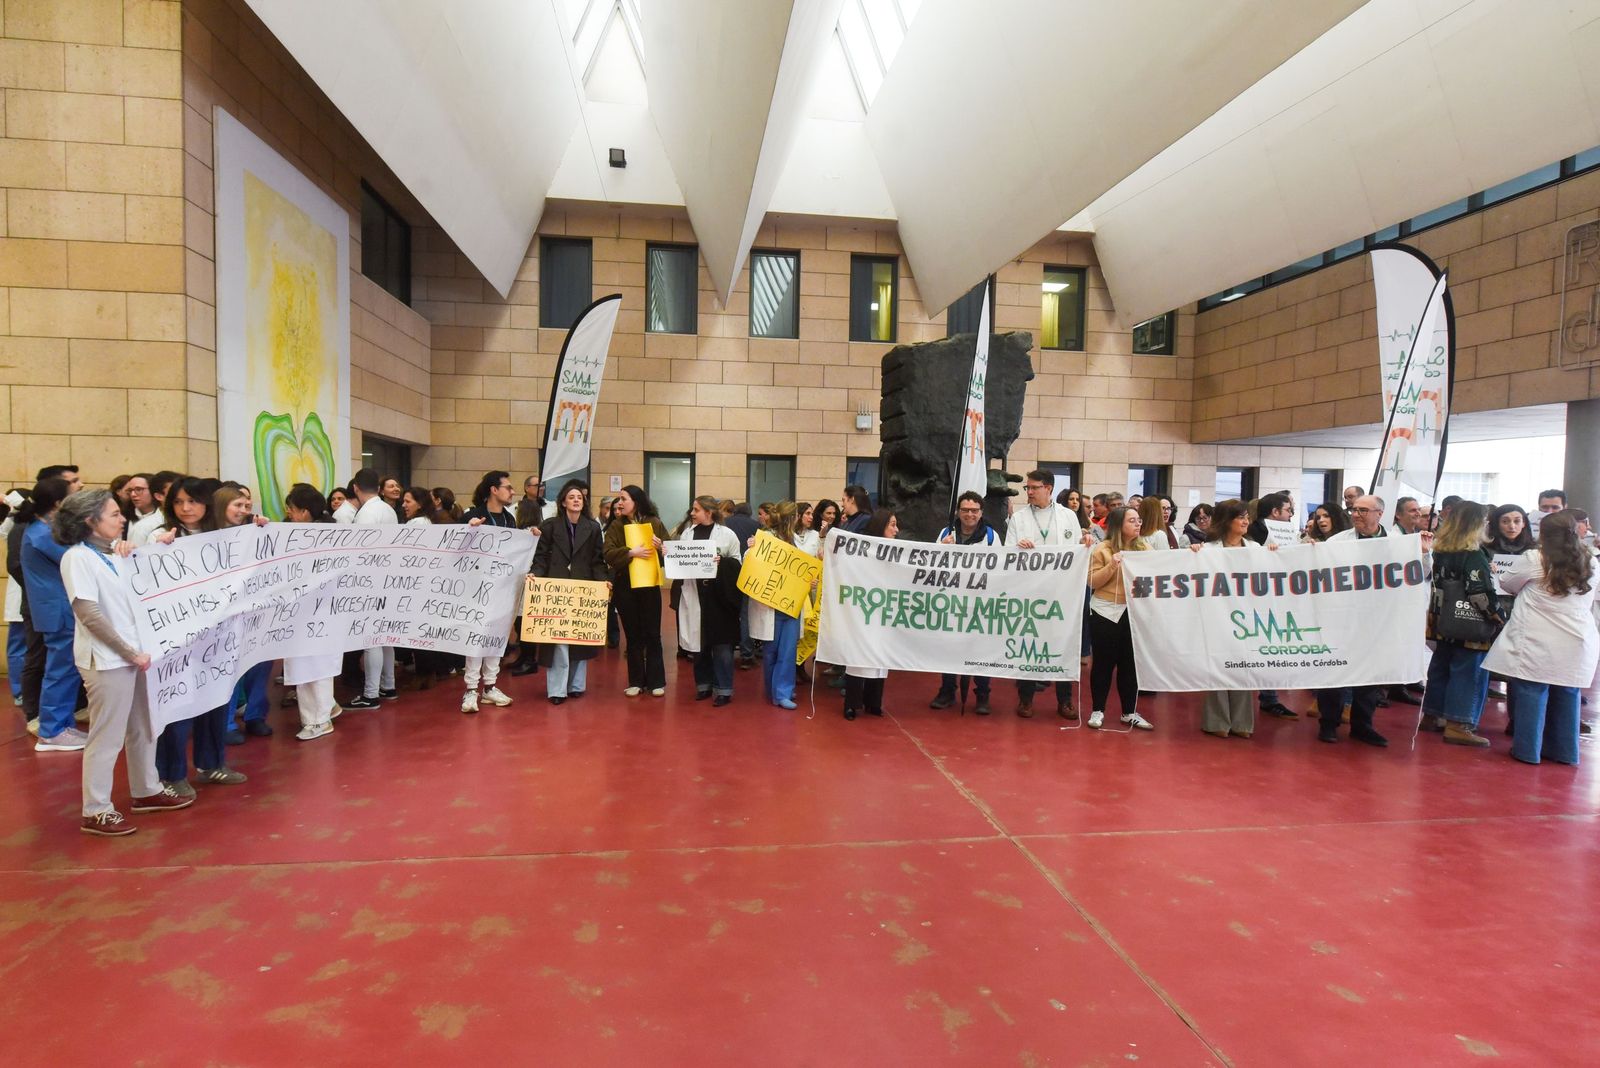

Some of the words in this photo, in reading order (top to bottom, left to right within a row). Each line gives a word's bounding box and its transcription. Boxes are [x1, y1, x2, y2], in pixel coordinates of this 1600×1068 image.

[562, 369, 597, 388] SMA
[255, 531, 280, 560] UN
[285, 528, 383, 553] ESTATUTO
[391, 528, 427, 548] DEL
[437, 527, 512, 554] MÉDICO?
[832, 534, 871, 558] POR
[875, 543, 904, 563] UN
[907, 548, 998, 571] ESTATUTO
[1003, 551, 1075, 572] PROPIO
[755, 538, 818, 583] MÉDICOS
[147, 608, 171, 632] EN
[172, 602, 190, 622] LA
[287, 561, 303, 582] LOS
[357, 552, 391, 567] SOMOS
[400, 555, 426, 568] SOLO
[429, 557, 444, 569] EL
[490, 560, 514, 577] ESTO
[383, 575, 424, 589] DONDE
[431, 576, 466, 597] SOLO
[472, 580, 494, 607] 18
[528, 581, 541, 592] UN
[544, 581, 597, 597] CONDUCTOR
[743, 575, 795, 611] HUELGA
[766, 569, 787, 591] EN
[912, 568, 961, 589] PARA
[966, 572, 988, 590] LA
[1131, 559, 1425, 599] #ESTATUTOMEDICO
[527, 605, 539, 616] 24
[542, 607, 567, 617] HORAS
[571, 608, 606, 620] SEGUIDAS
[530, 594, 541, 604] NO
[546, 594, 575, 607] PUEDE
[838, 584, 969, 618] PROFESIÓN
[972, 591, 1065, 621] MÉDICA
[1455, 600, 1470, 610] 66
[533, 617, 554, 626] PERO
[860, 603, 878, 625] Y
[881, 606, 1039, 638] FACULTATIVA
[1230, 607, 1321, 643] SMA
[157, 650, 192, 683] VIVEN
[202, 638, 220, 663] EN
[224, 631, 239, 652] EL
[270, 602, 300, 628] PISO
[313, 598, 323, 616] Y
[396, 596, 412, 612] EL
[1005, 638, 1061, 664] SMA
[157, 681, 187, 704] PERO
[195, 670, 207, 690] LO
[261, 625, 295, 647] OTROS
[348, 616, 369, 636] ASÍ
[373, 616, 411, 634] SIEMPRE
[418, 622, 460, 642] SALIMOS
[465, 631, 506, 649] PERDIENDO
[1224, 660, 1265, 669] Sindicato
[1267, 659, 1299, 668] Médico
[1300, 659, 1311, 667] de
[1312, 658, 1348, 667] Córdoba
